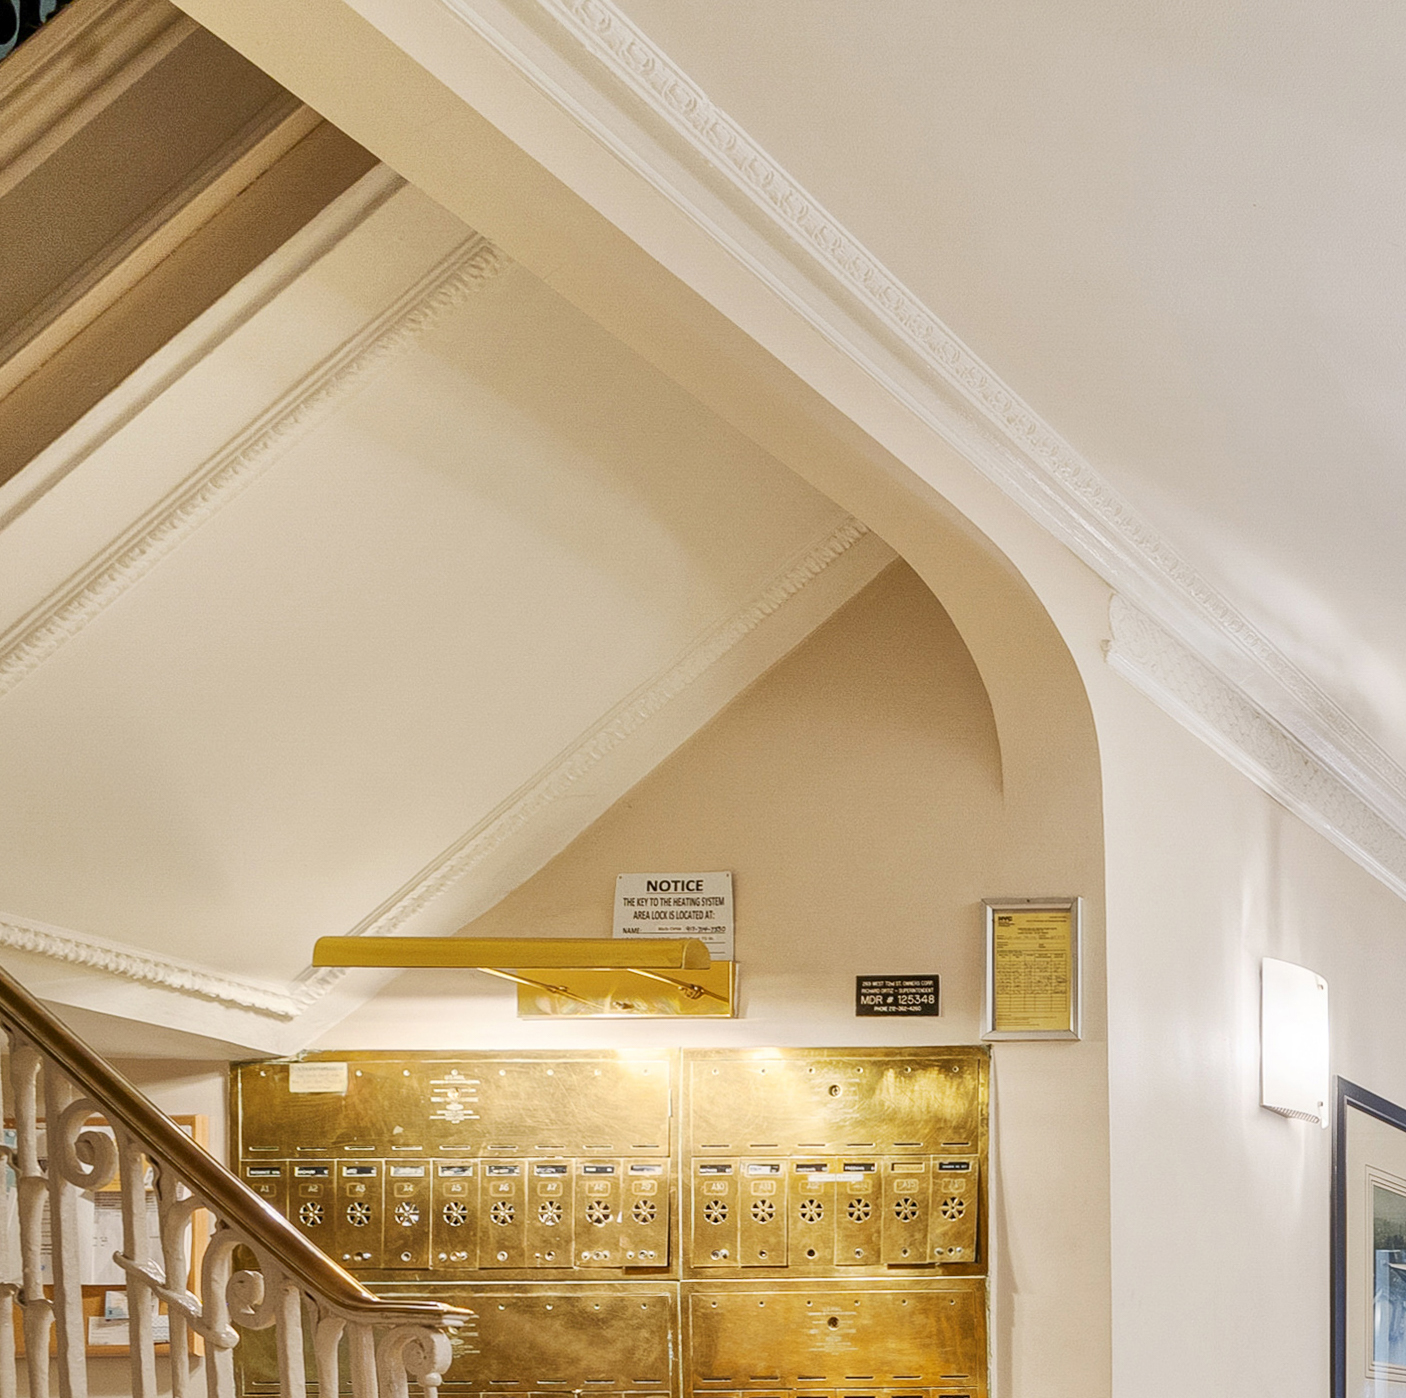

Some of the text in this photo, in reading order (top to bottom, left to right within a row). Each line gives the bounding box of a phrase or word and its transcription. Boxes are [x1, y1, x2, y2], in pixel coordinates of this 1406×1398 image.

[647, 880, 703, 891] NOTICE
[623, 897, 724, 906] THE KEY TO THE HEATING SYSTEM
[633, 911, 715, 919] AREA LOCK IS LOCATED AT:
[861, 995, 883, 1004] MDR
[898, 995, 935, 1004] 125348
